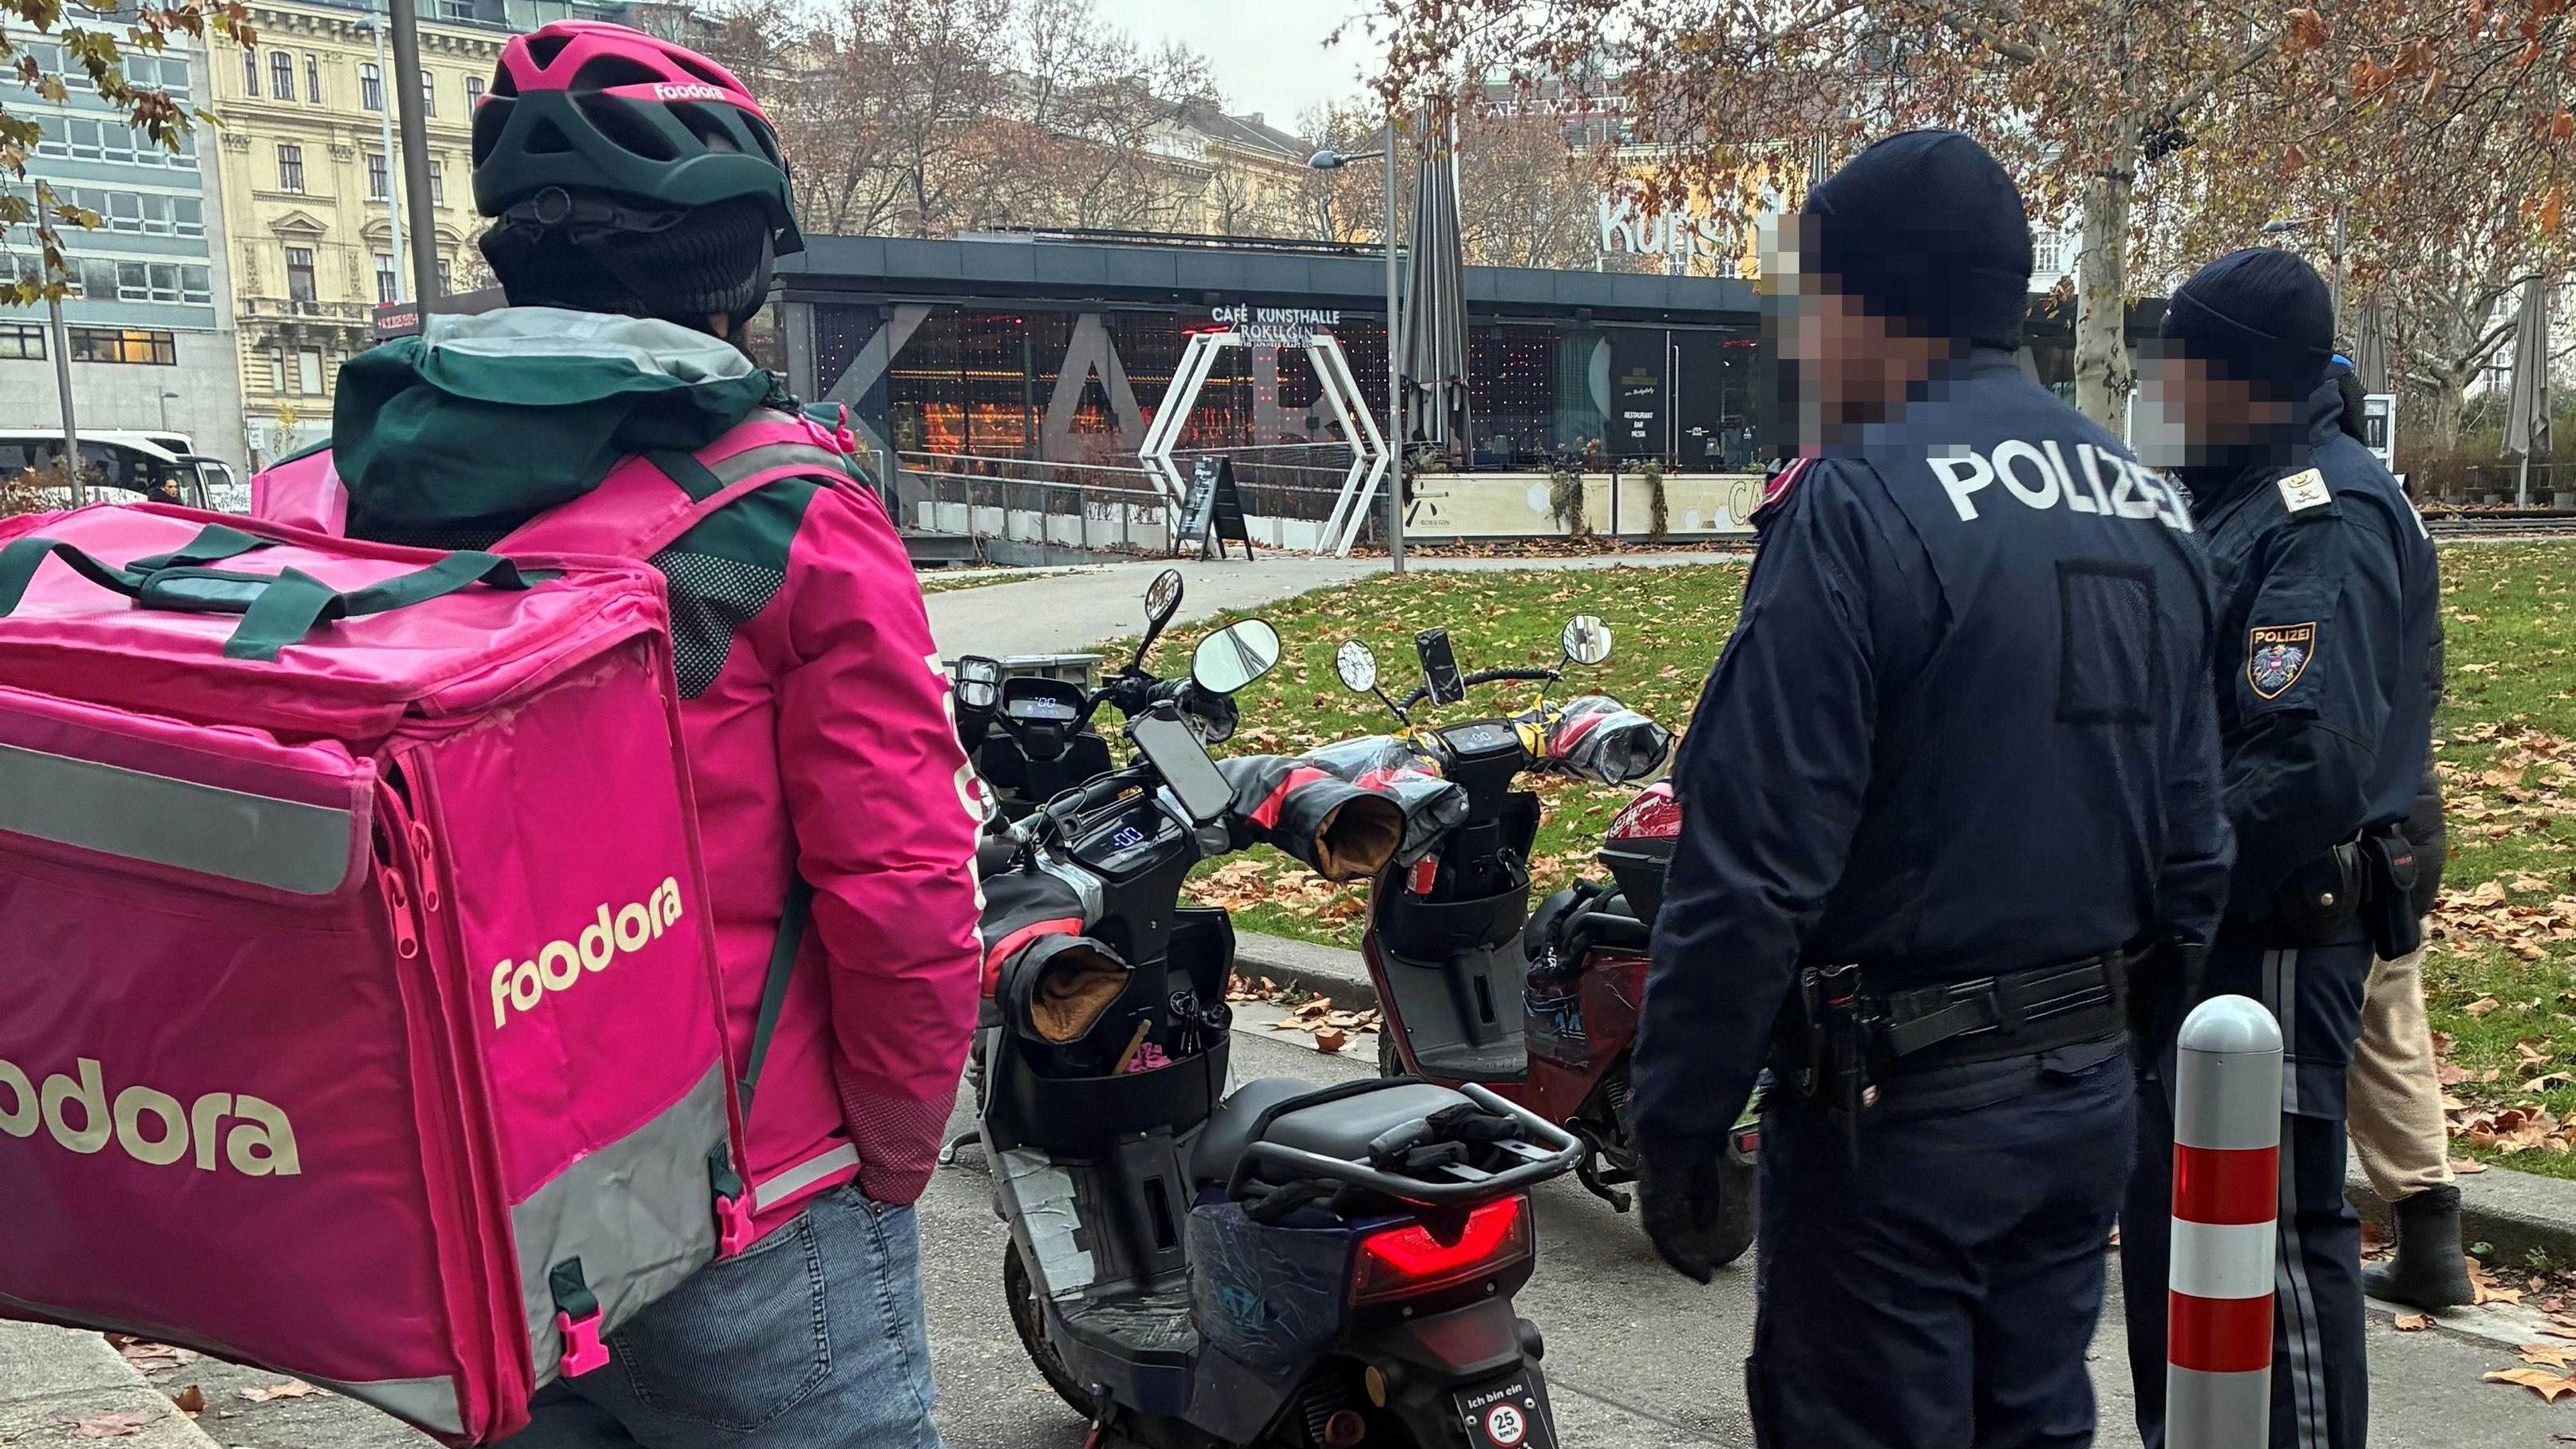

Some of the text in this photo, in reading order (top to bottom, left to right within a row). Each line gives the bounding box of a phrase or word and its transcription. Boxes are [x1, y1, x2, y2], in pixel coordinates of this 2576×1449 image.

[654, 83, 726, 101] foodora
[1211, 303, 1340, 325] CAFÉ KUNSTHALLE
[1240, 324, 1314, 340] ROKU GIN
[2255, 629, 2309, 644] POLIZEI
[491, 876, 683, 1030] foodora
[1468, 1384, 1523, 1410] Ich bin ein
[1495, 1411, 1515, 1430] 25
[1499, 1427, 1519, 1439] km/h
